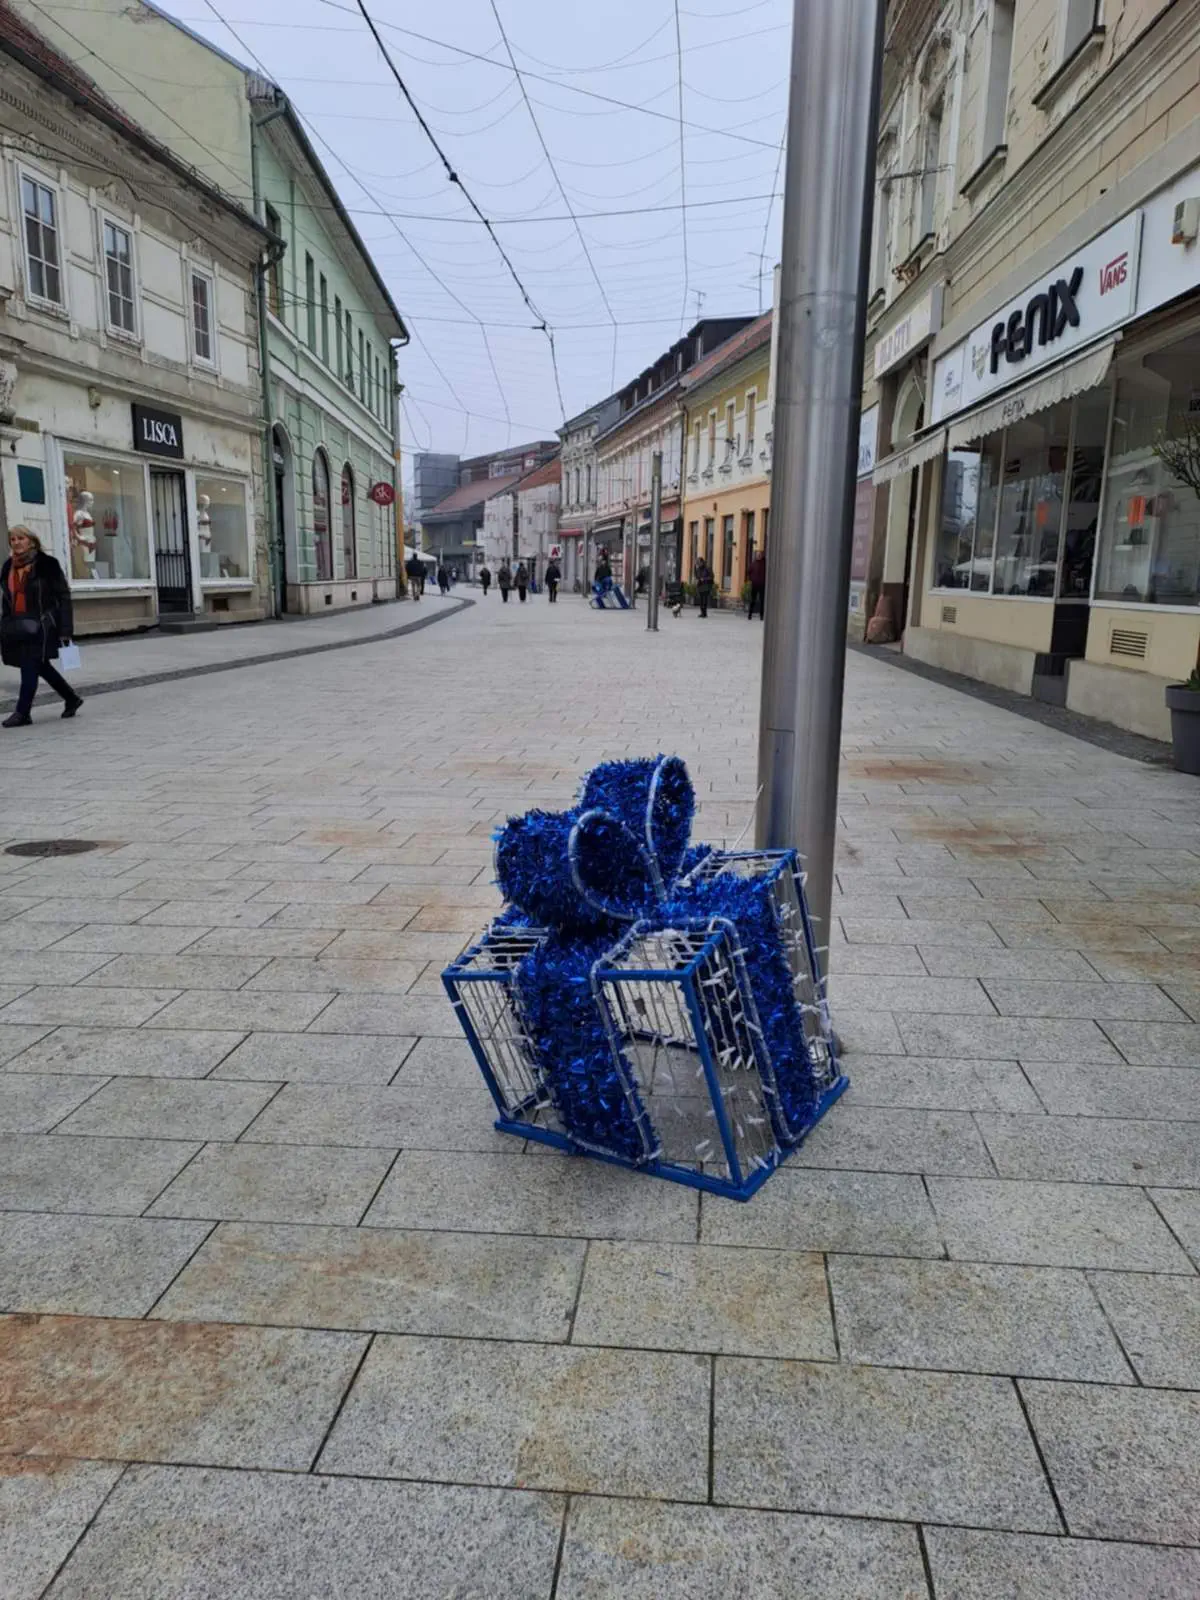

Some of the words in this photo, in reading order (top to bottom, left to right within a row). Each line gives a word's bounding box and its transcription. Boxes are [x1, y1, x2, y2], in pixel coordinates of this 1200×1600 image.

[1100, 251, 1128, 296] VANS
[990, 266, 1084, 375] FENIX
[142, 417, 178, 447] LISCA
